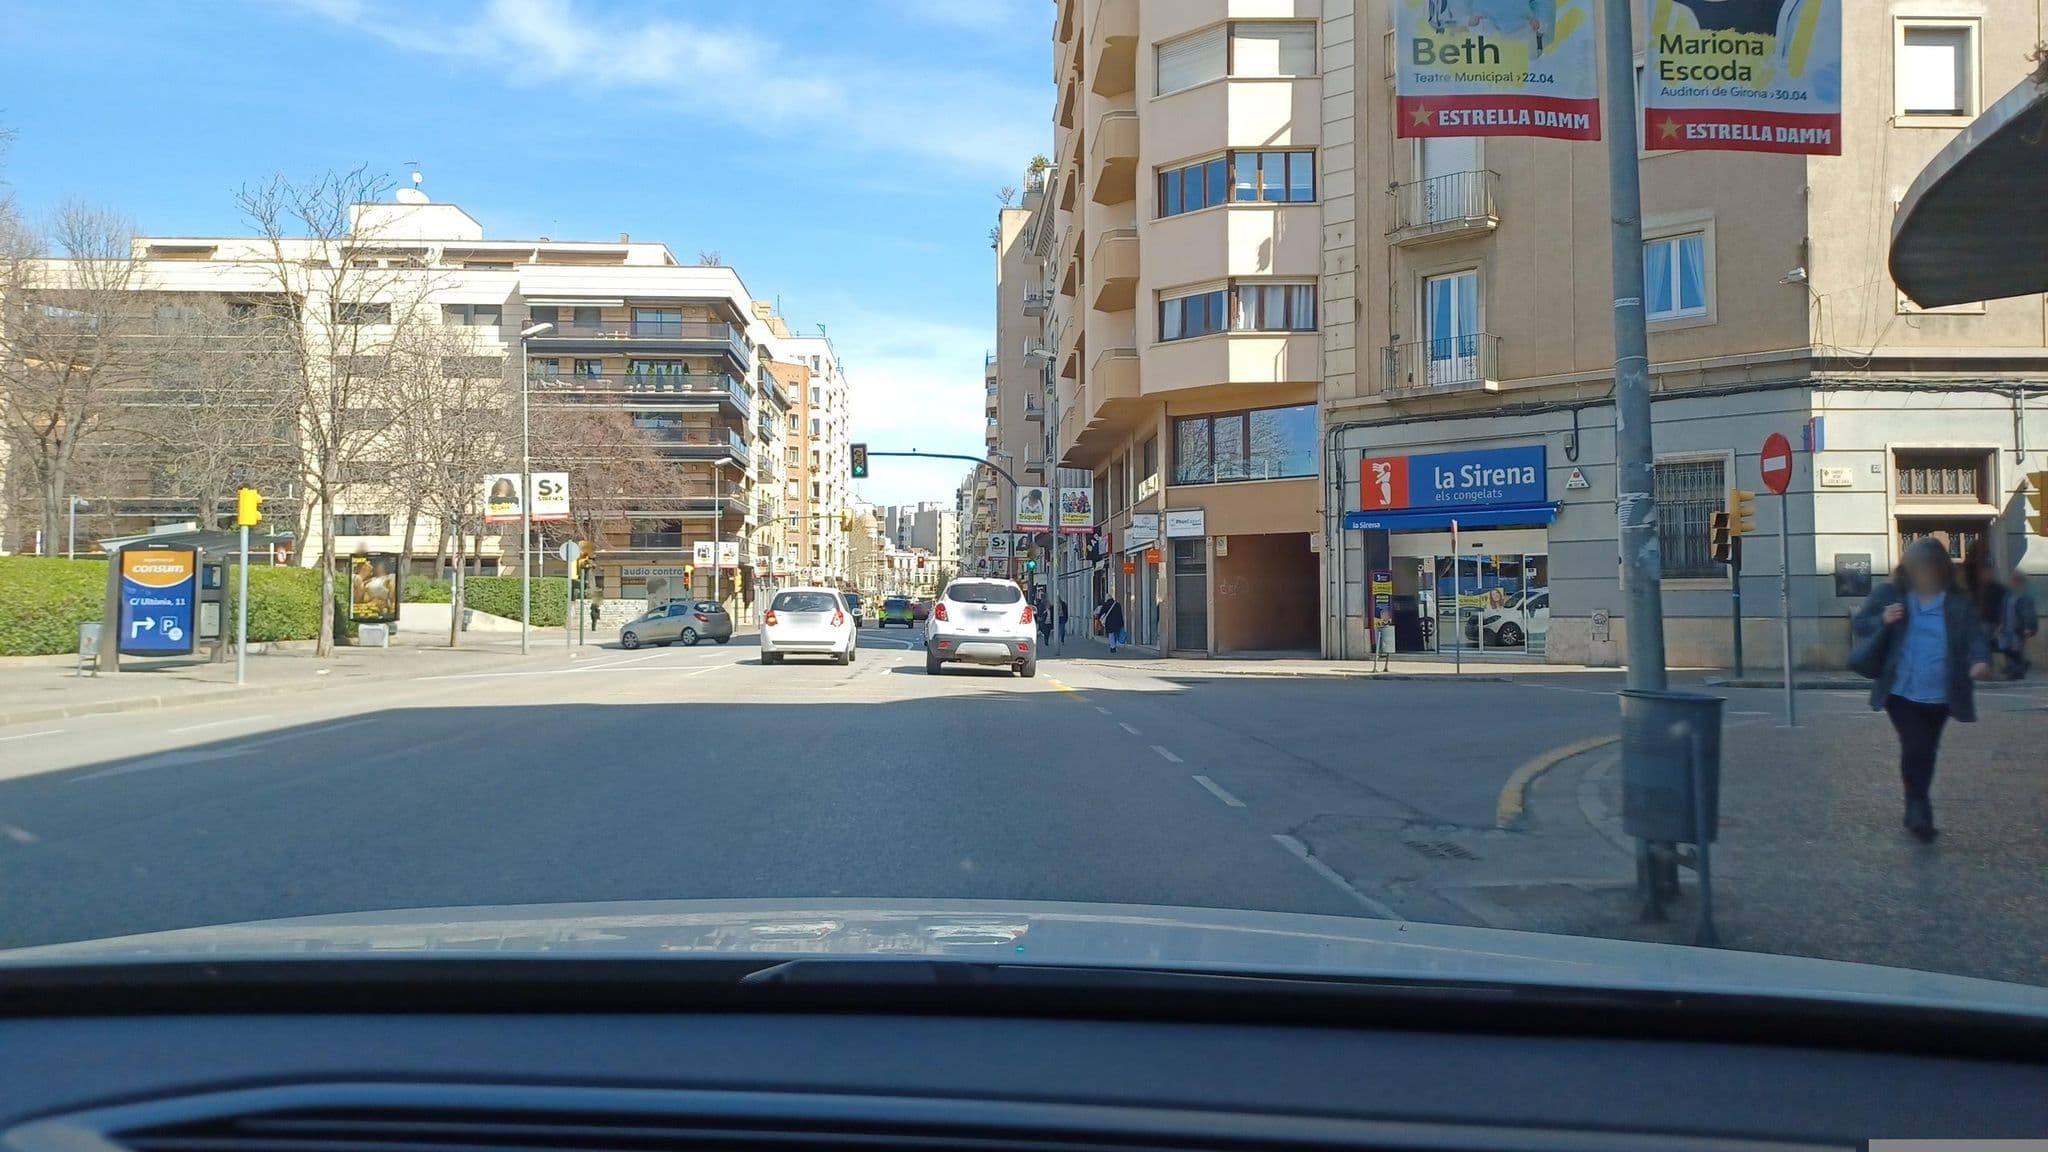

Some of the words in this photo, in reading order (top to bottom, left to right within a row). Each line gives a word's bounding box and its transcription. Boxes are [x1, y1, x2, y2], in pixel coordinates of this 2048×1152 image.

[1412, 35, 1500, 65] Beth
[1659, 33, 1764, 56] Mariona
[1660, 59, 1752, 82] Escoda
[1415, 72, 1451, 83] Teatre
[1455, 71, 1513, 84] Municipal
[1660, 85, 1709, 97] Auditori
[1711, 86, 1728, 97] de
[1730, 86, 1768, 98] Girona
[1439, 108, 1530, 126] ESTRELLA
[1534, 109, 1590, 129] DAMM
[1686, 123, 1773, 141] ESTRELLA
[1775, 127, 1832, 145] DAMM
[1434, 466, 1455, 490] la
[1460, 463, 1536, 488] Sirena
[1435, 491, 1451, 501] els
[1453, 489, 1503, 502] congelats
[1360, 521, 1381, 529] Sirena
[132, 564, 184, 573] consum
[623, 567, 650, 576] audio
[175, 598, 186, 606] 11
